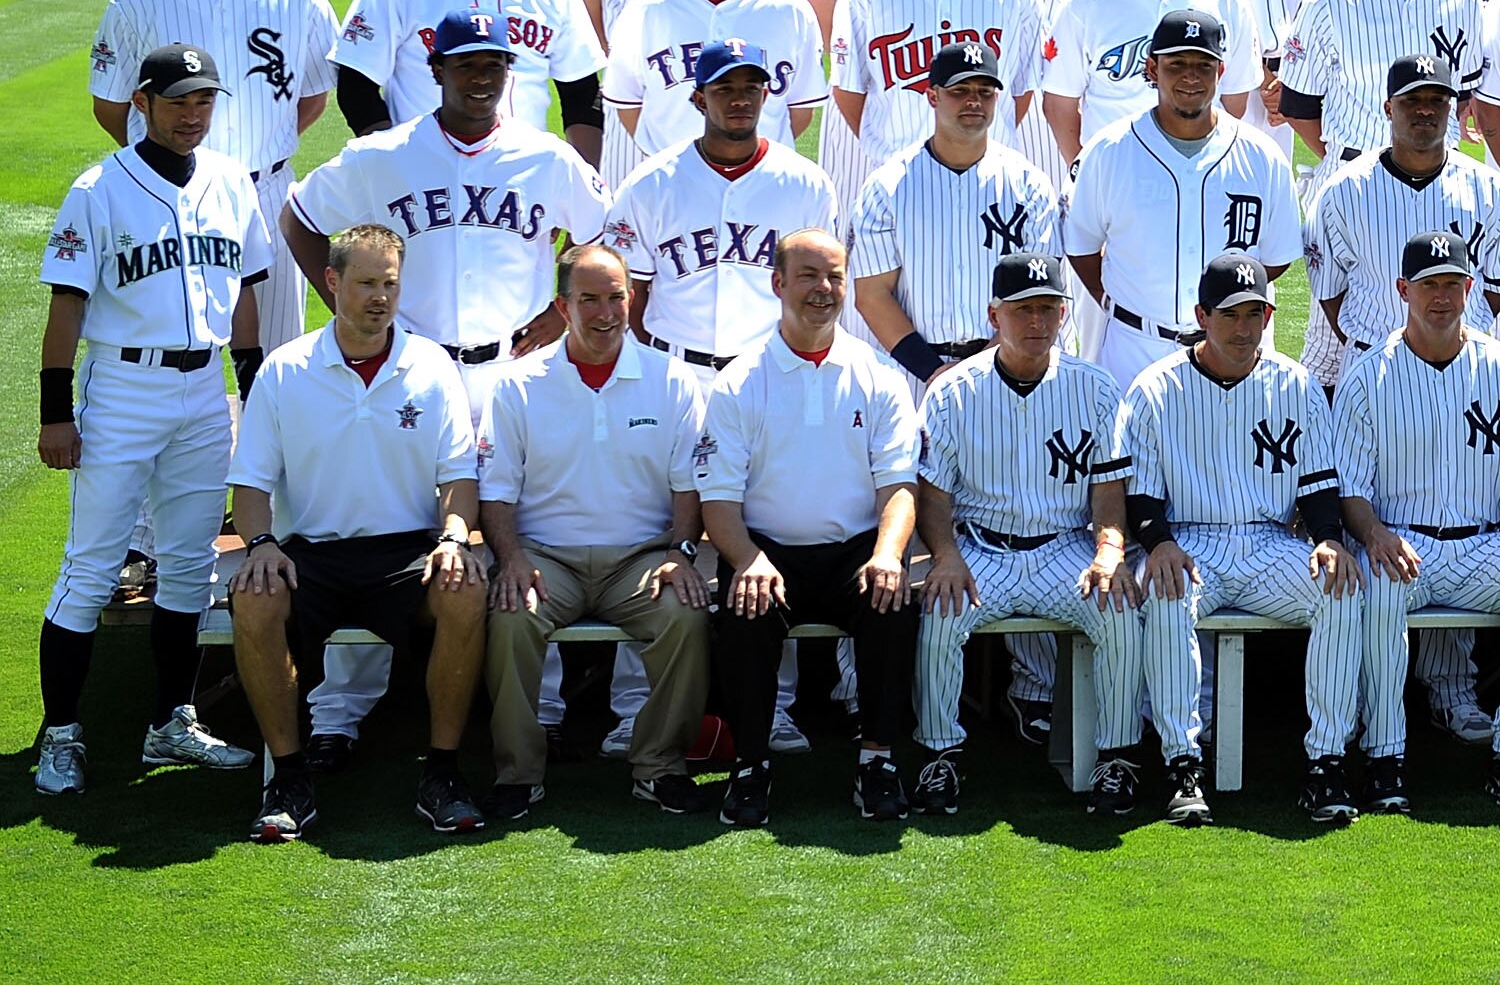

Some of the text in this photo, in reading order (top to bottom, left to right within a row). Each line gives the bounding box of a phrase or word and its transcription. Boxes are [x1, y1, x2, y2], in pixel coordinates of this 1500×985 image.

[507, 17, 554, 54] SOX
[962, 43, 984, 65] NY
[1414, 56, 1436, 75] NY
[386, 183, 547, 243] TEXAS
[980, 201, 1029, 257] NY
[1222, 190, 1264, 252] D
[656, 219, 779, 280] TEXA
[1026, 257, 1049, 281] NY
[1429, 235, 1451, 258] NY
[1234, 262, 1257, 286] NY
[1044, 428, 1096, 485] NY
[1249, 417, 1303, 474] NY
